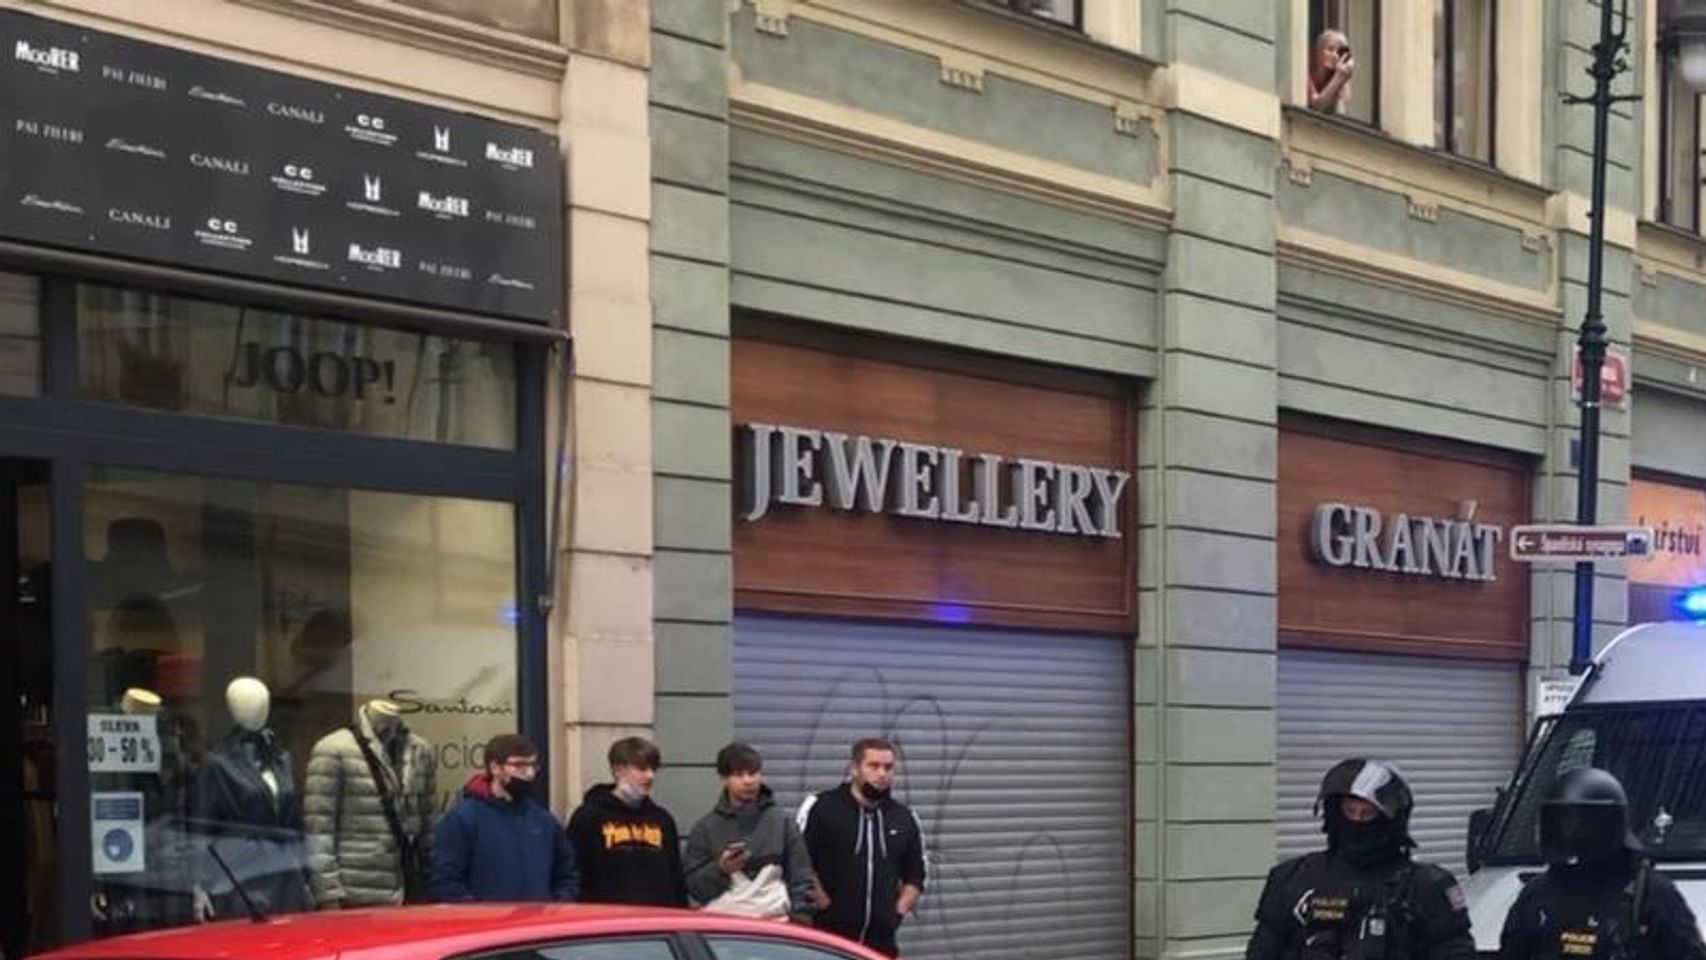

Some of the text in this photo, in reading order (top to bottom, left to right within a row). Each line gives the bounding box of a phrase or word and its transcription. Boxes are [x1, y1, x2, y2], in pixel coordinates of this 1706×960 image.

[267, 102, 325, 124] CANALI
[190, 153, 249, 175] CANALI
[108, 208, 171, 230] CANALI
[236, 341, 396, 405] JOOP!
[744, 421, 1131, 538] JEWELLERY
[1312, 499, 1503, 583] GRANÁT
[388, 689, 514, 715] Santoni
